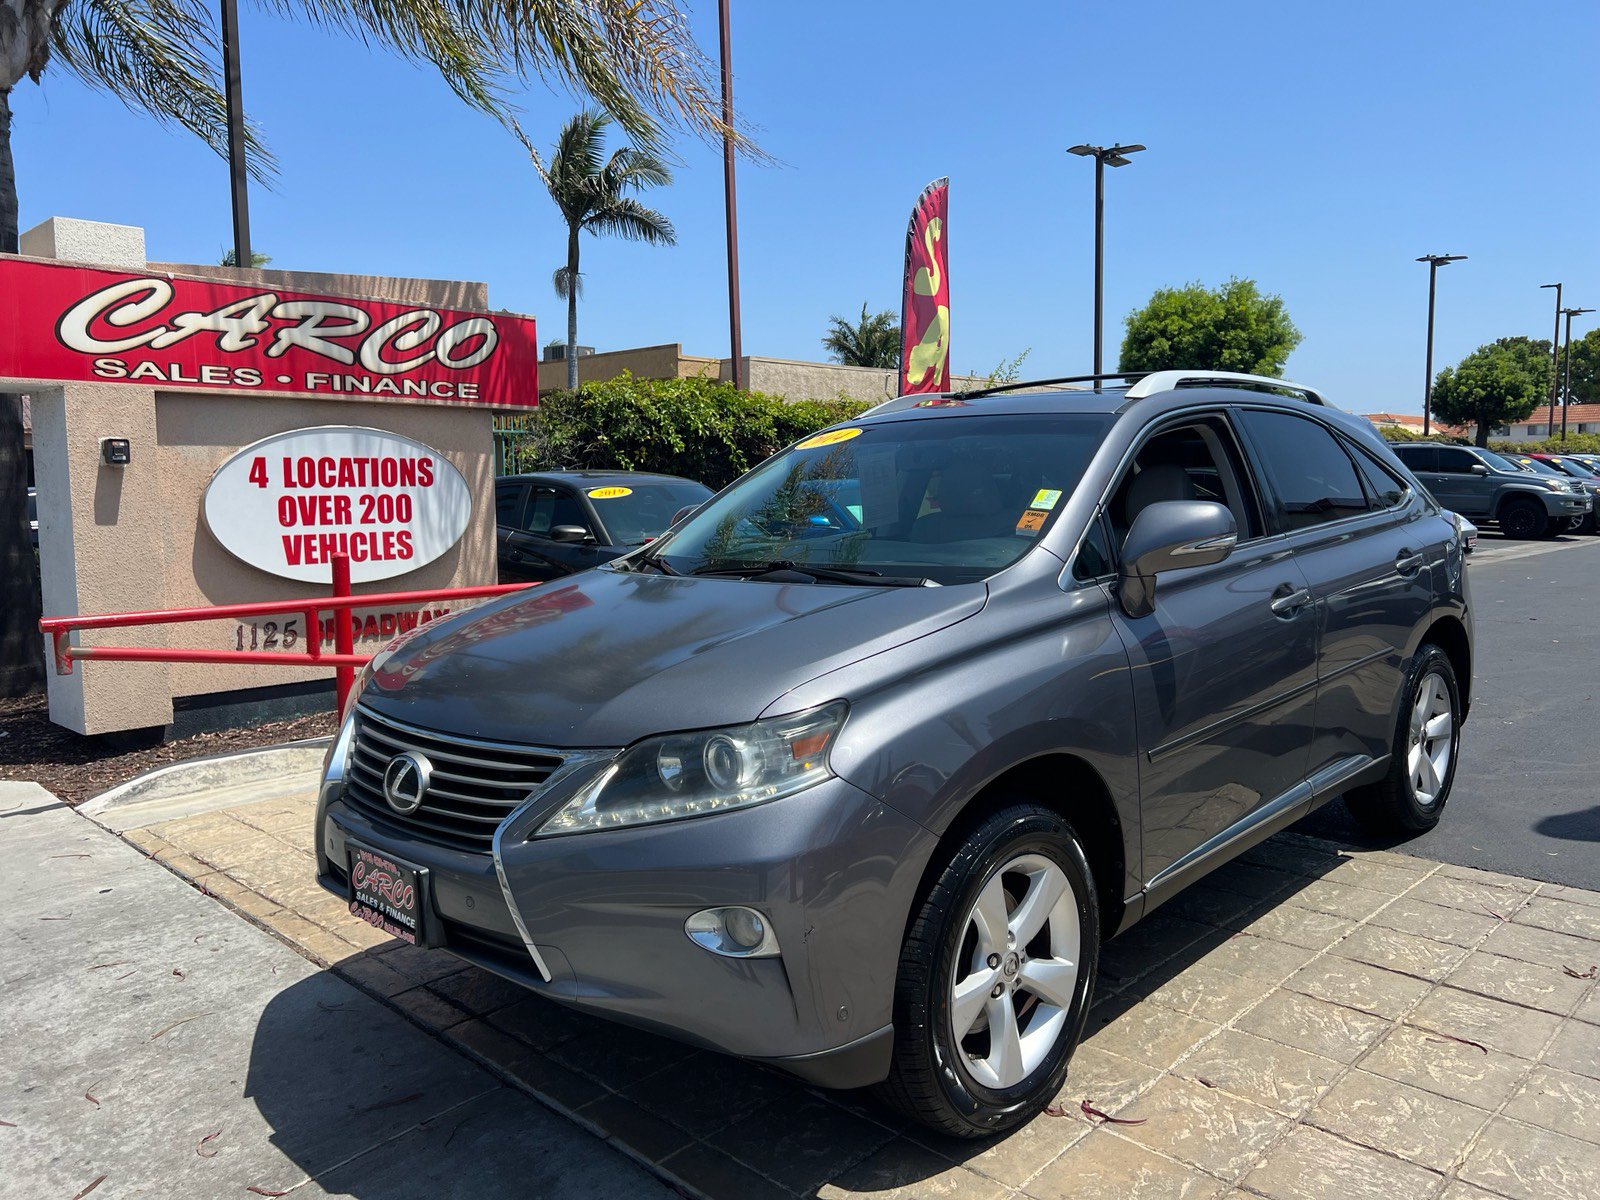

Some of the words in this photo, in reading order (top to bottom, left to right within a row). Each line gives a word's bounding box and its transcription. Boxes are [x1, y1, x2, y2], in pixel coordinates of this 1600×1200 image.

[55, 278, 499, 374] CARCO
[92, 358, 263, 386] SALES
[305, 371, 480, 399] FINANCE
[248, 456, 269, 488] 4
[283, 456, 434, 489] LOCATIONS
[278, 495, 352, 527] OVER
[358, 493, 412, 524] 200
[599, 488, 625, 497] 2019
[281, 530, 414, 566] VEHICLES
[236, 619, 298, 650] 1125
[352, 861, 415, 910] CARCO
[356, 891, 378, 908] SALES
[379, 902, 387, 912] &
[386, 905, 416, 928] FINANCE
